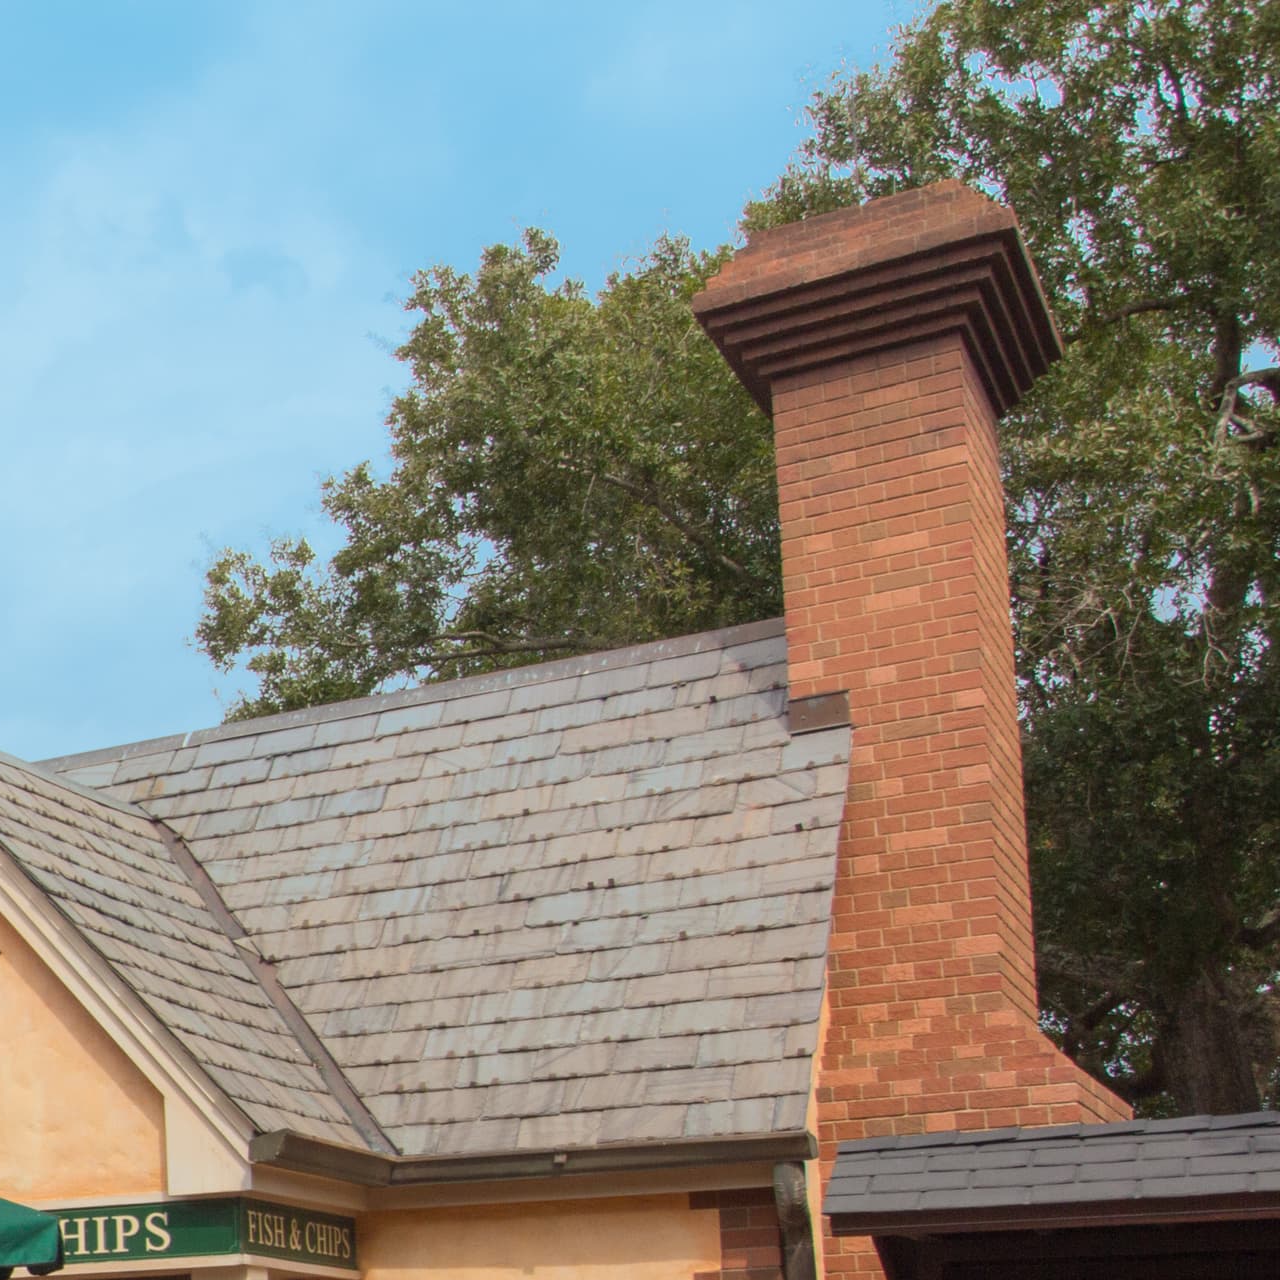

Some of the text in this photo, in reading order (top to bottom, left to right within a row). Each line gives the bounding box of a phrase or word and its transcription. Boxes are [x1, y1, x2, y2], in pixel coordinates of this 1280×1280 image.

[58, 1211, 172, 1256] HIPS
[247, 1210, 351, 1259] FISH & CHIPS
